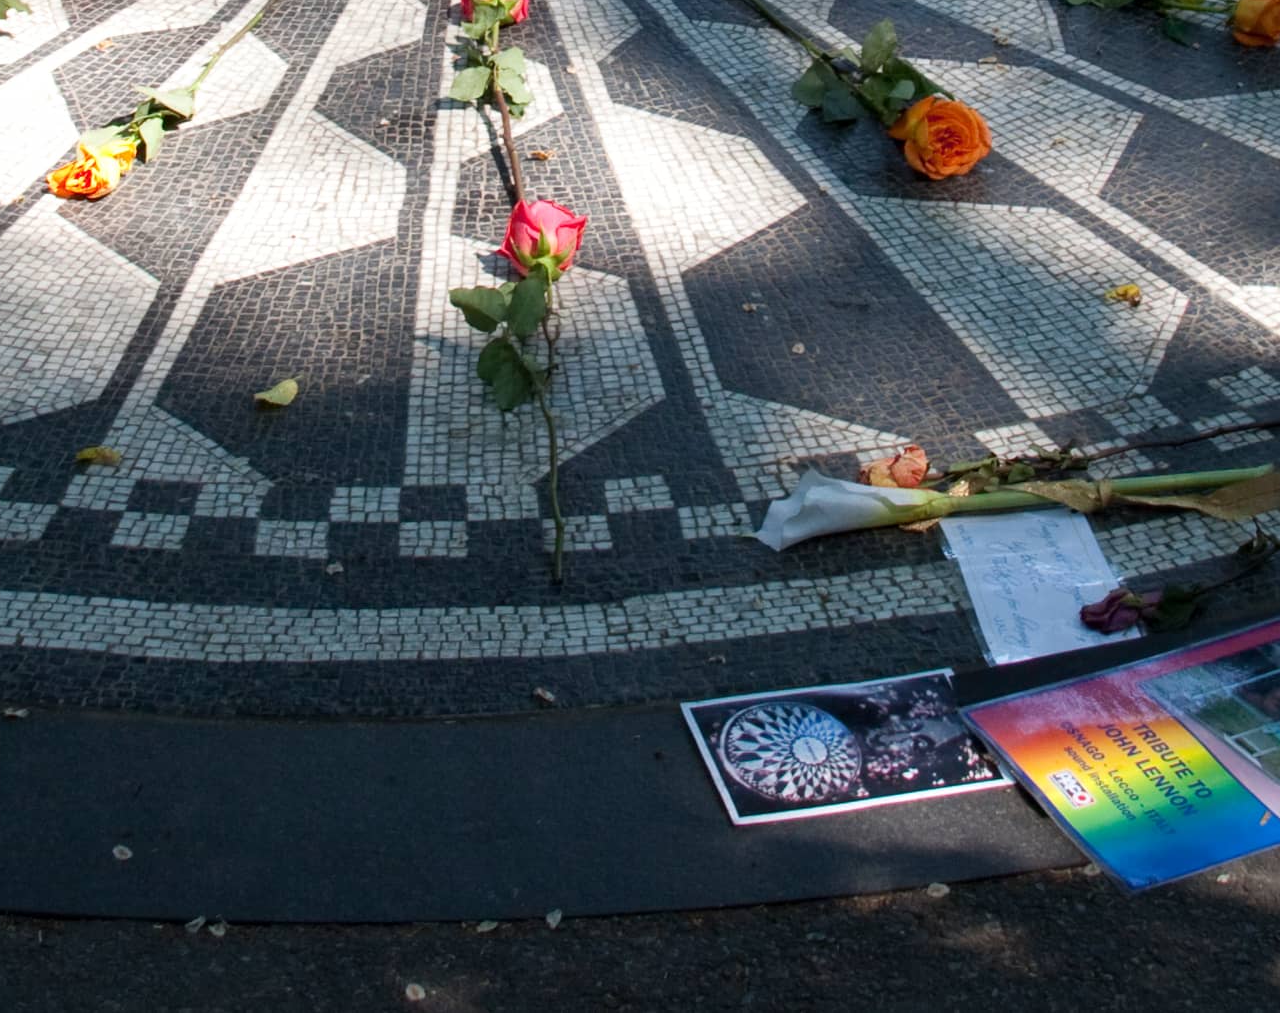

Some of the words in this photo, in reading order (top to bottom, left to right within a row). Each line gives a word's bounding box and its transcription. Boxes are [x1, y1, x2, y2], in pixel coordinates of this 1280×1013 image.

[1060, 720, 1105, 761] OSNAGO
[1108, 769, 1139, 801] Lecco
[1144, 808, 1177, 835] ITALY
[1064, 744, 1092, 772] sound
[1088, 772, 1137, 821] installation
[1097, 723, 1142, 757] JOHN
[1136, 758, 1199, 817] LENNON
[1133, 723, 1194, 779] TRIBUTE
[1188, 779, 1213, 799] TO
